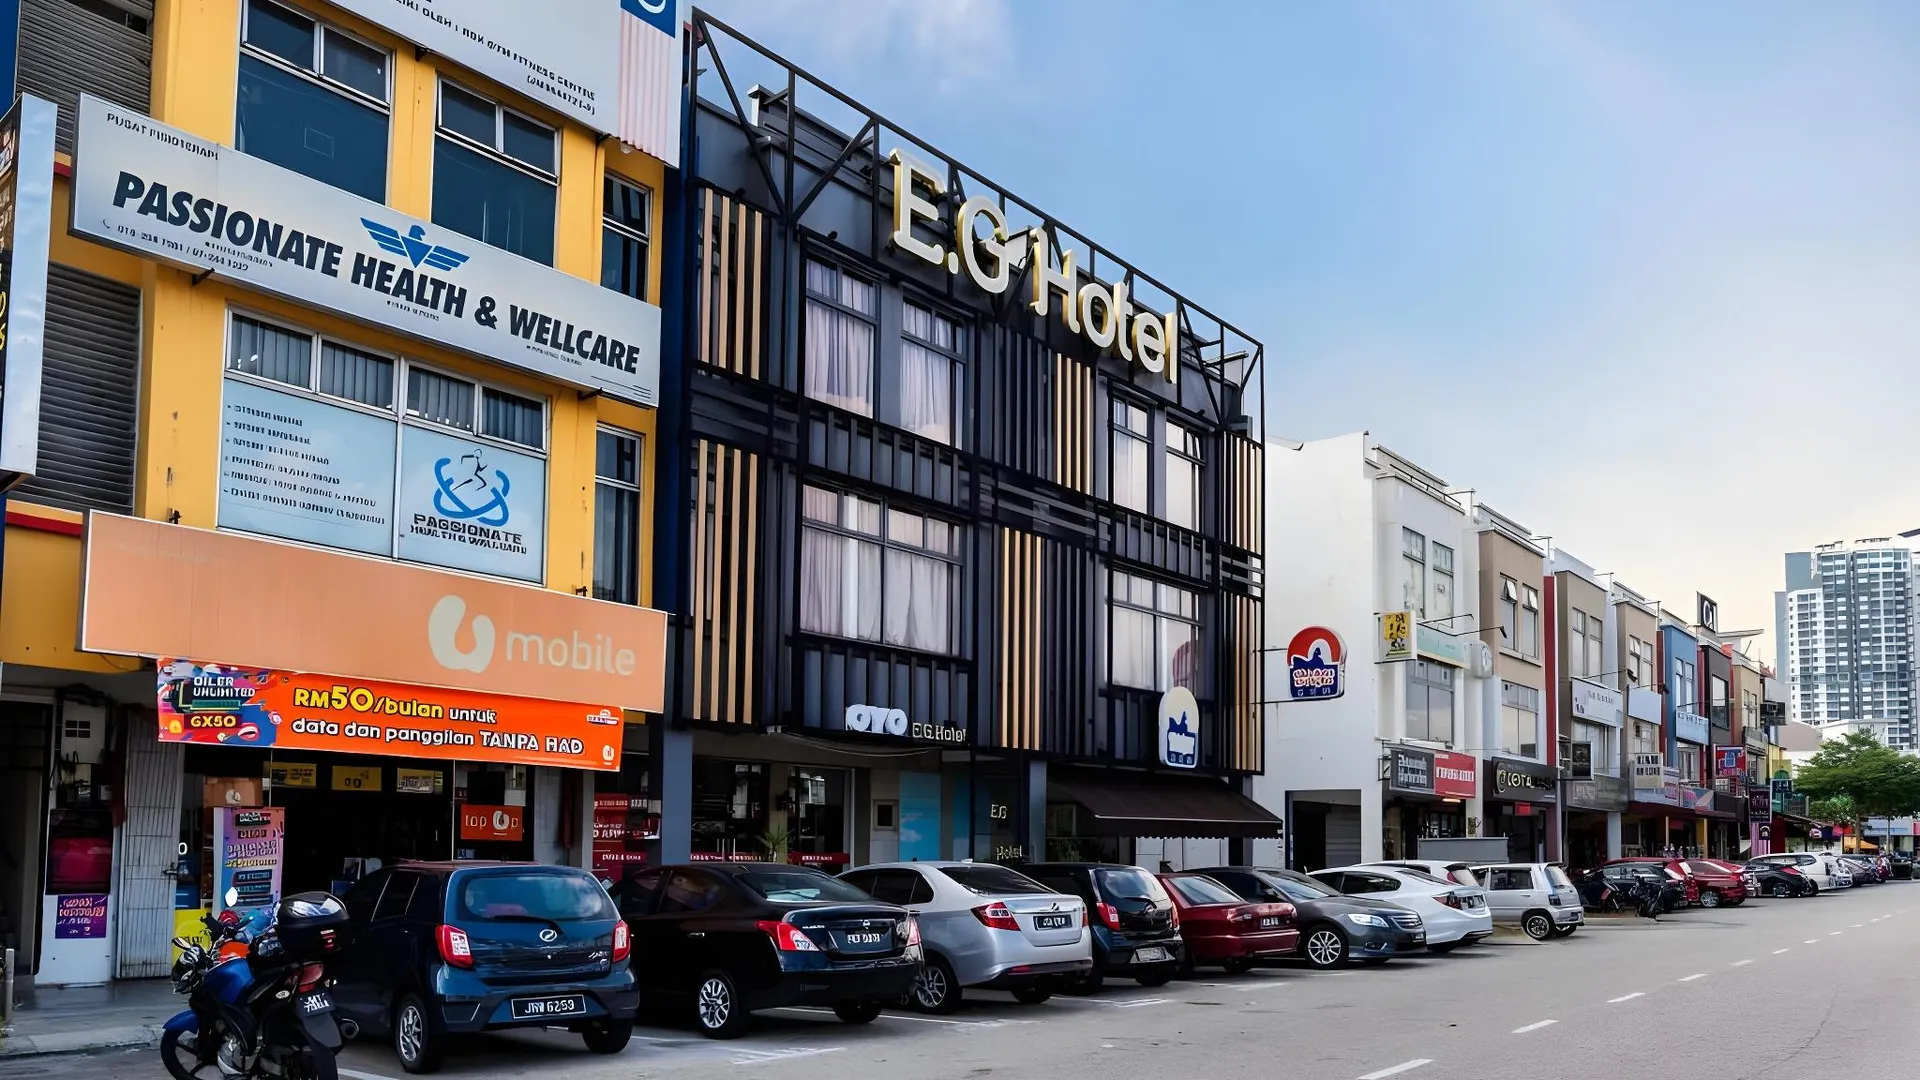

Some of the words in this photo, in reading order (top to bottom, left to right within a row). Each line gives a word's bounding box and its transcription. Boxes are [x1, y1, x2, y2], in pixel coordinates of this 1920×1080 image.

[113, 171, 344, 279] PASSIONATE
[351, 251, 468, 319] HEALTH
[474, 295, 498, 331] &
[509, 304, 641, 375] WELLCARE
[1029, 226, 1179, 385] Hotel
[506, 630, 636, 676] mobile
[190, 715, 237, 728] GX50
[291, 717, 340, 736] data
[344, 721, 381, 739] dan
[385, 727, 475, 747] panggilan
